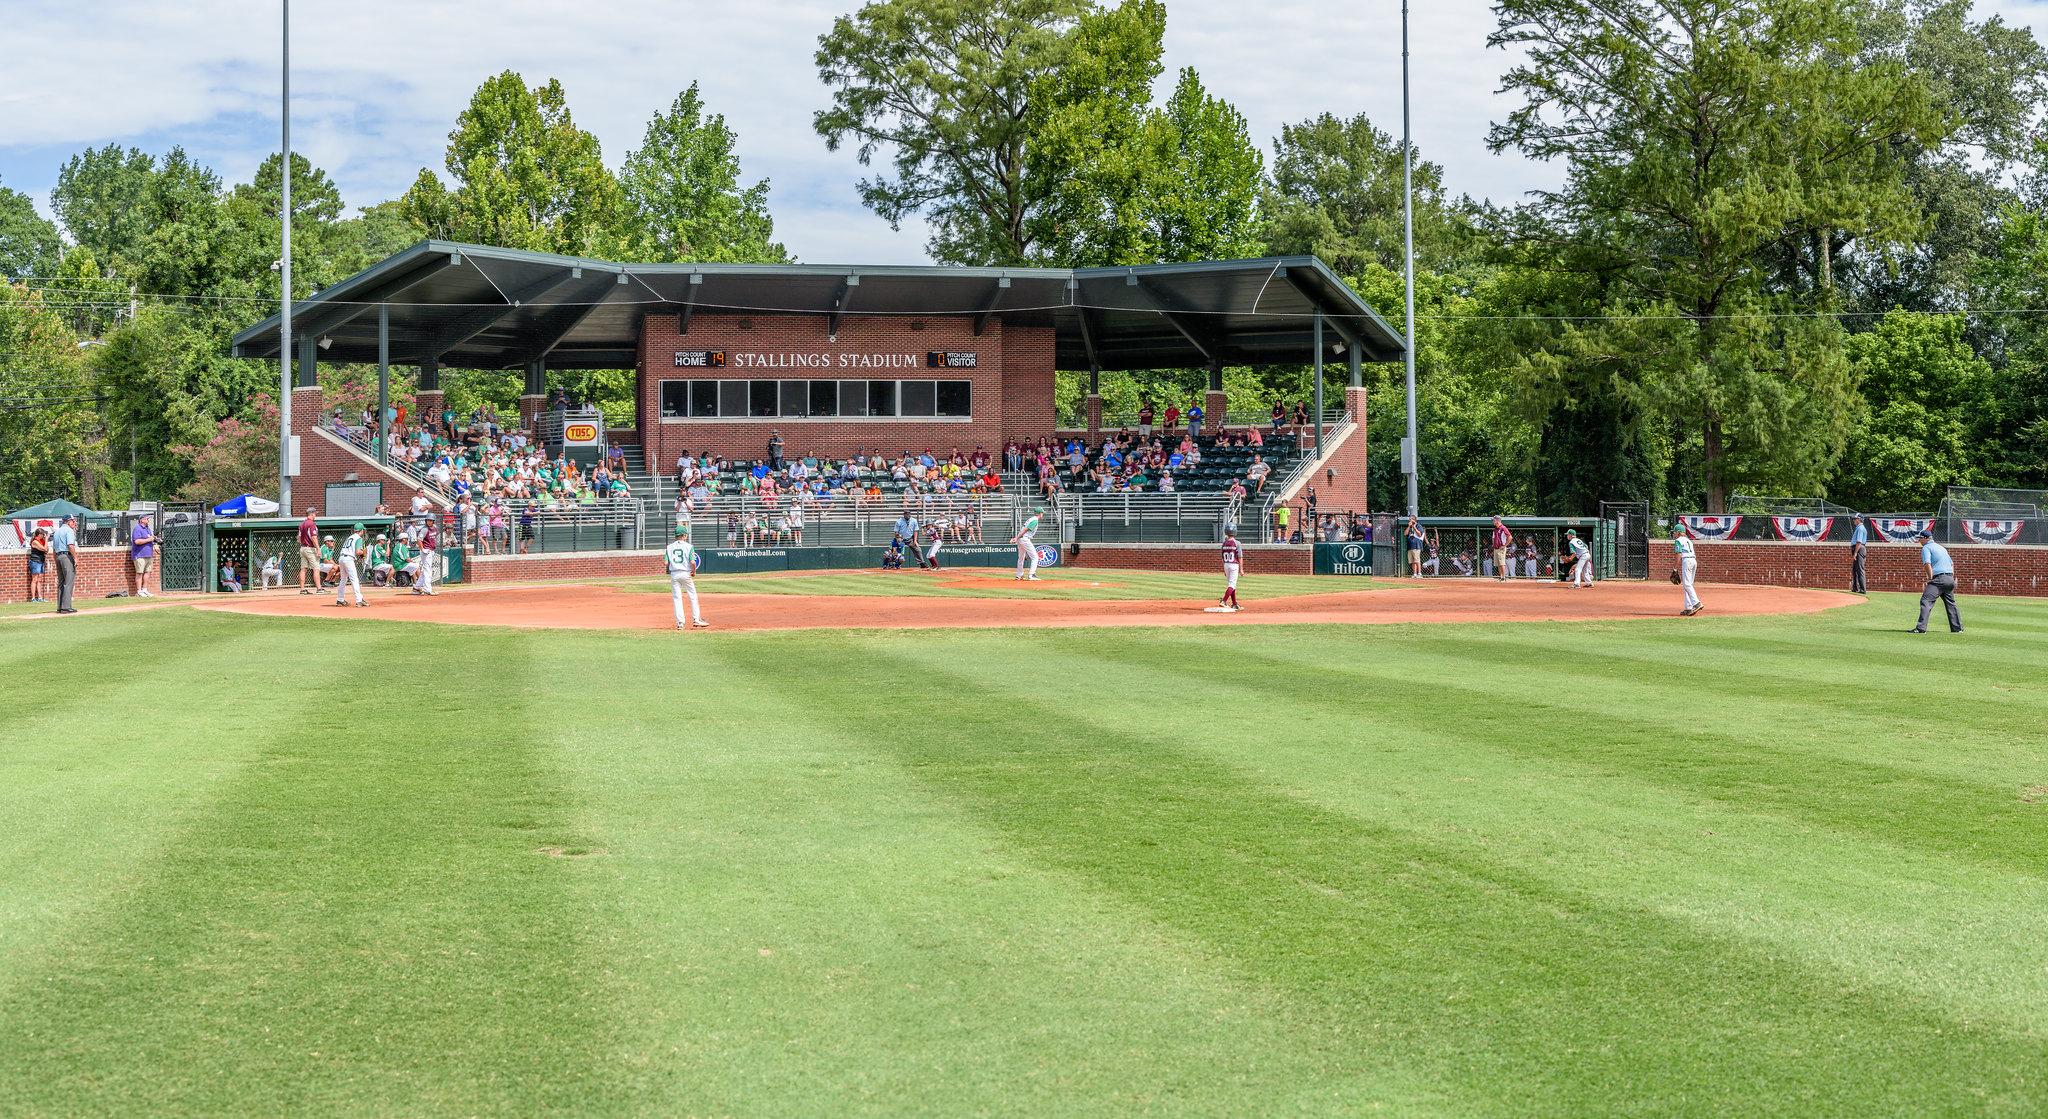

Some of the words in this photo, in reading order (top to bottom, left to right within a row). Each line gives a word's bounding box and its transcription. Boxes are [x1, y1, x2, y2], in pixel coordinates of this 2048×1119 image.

[675, 357, 706, 366] HOME
[735, 353, 830, 367] STALLINGS
[839, 353, 918, 368] STADIUM
[947, 357, 976, 366] VISITOR
[571, 428, 590, 436] TOSC
[673, 548, 684, 563] 3
[1333, 561, 1372, 575] Hilton
